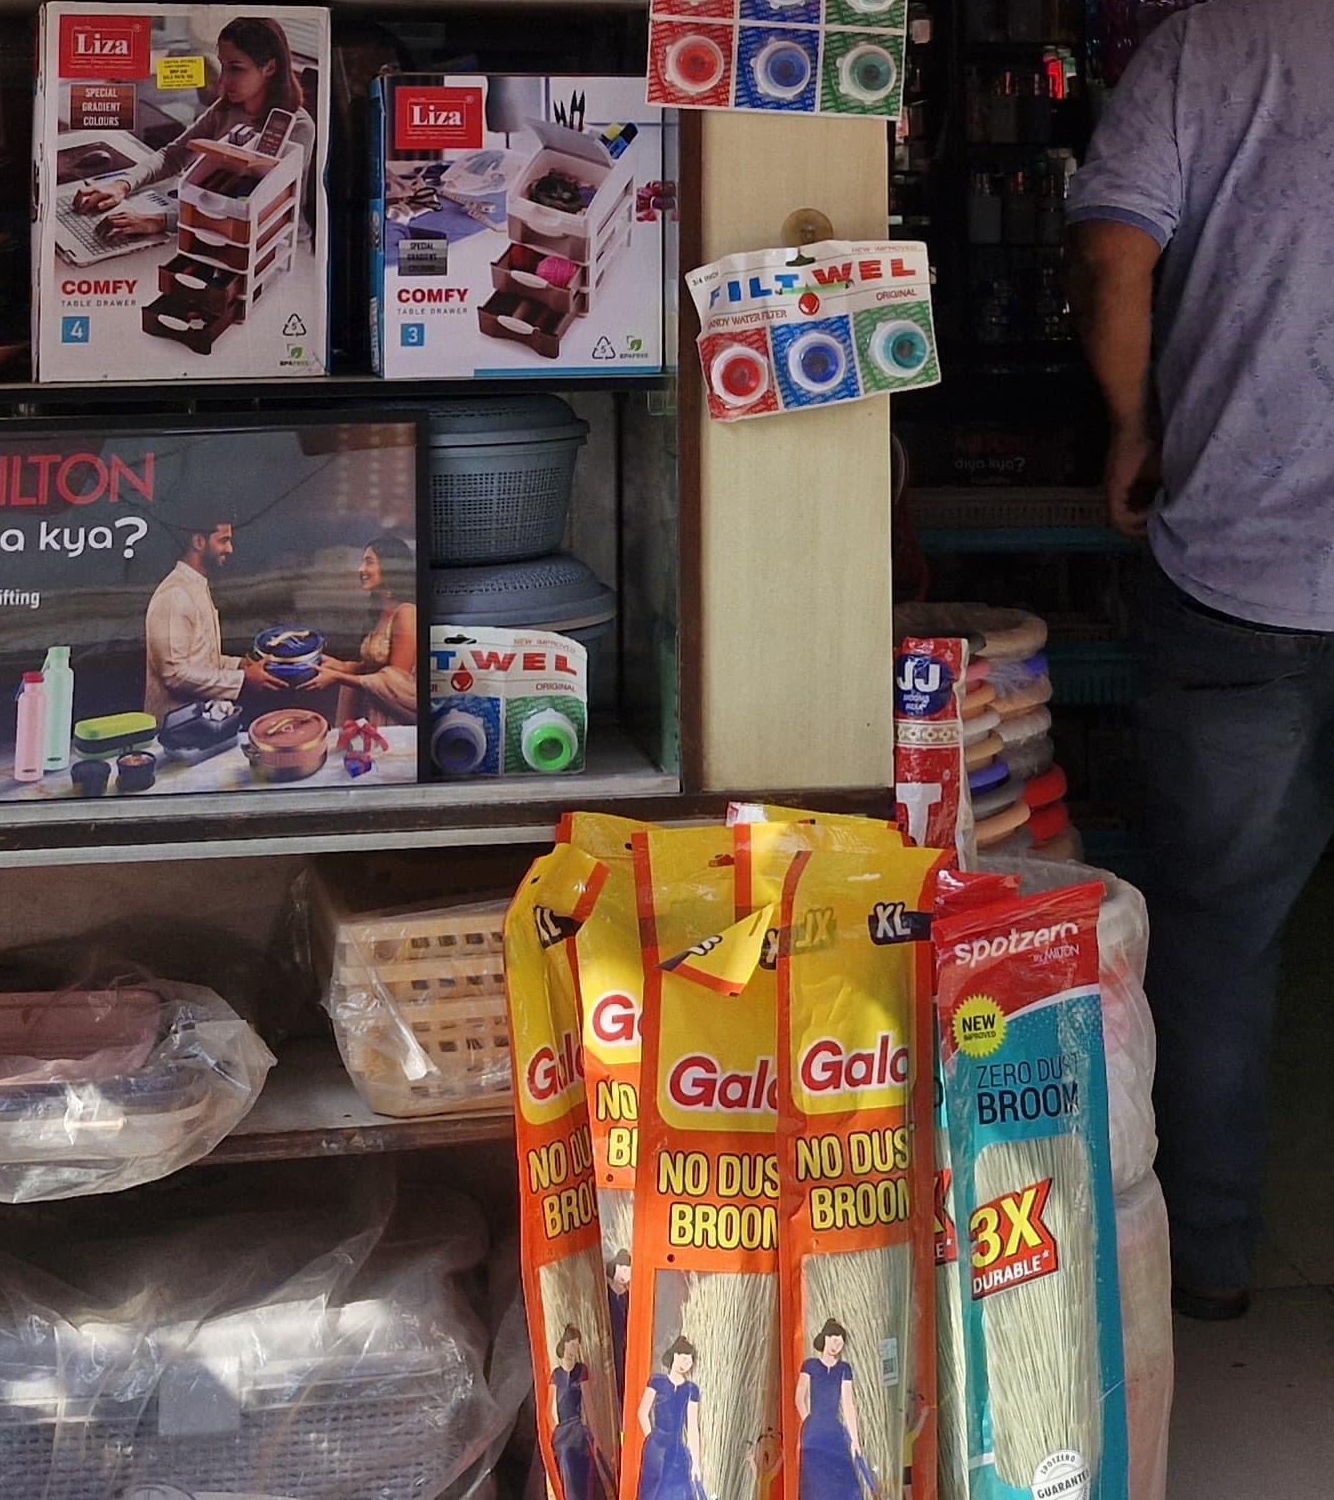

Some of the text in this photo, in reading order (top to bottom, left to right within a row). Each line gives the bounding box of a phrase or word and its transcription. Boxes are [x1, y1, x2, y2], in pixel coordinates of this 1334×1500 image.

[75, 33, 128, 55] Liza
[85, 87, 117, 98] SPECIAL
[82, 102, 120, 112] GRADIENT
[411, 105, 462, 127] Liza
[83, 116, 120, 126] COLOURS
[61, 280, 137, 295] COMFY
[397, 288, 468, 303] COMFY
[70, 320, 83, 338] 4
[707, 317, 731, 330] ANDY
[407, 327, 418, 343] 3
[39, 516, 149, 560] kya?
[875, 904, 912, 940] XL
[962, 1012, 997, 1032] NEW
[977, 1059, 1031, 1089] ZERO
[977, 1082, 1079, 1126] BROOM
[795, 1125, 914, 1182] NO DUS
[528, 1139, 567, 1195] NO
[658, 1151, 779, 1200] NO DUS
[970, 1187, 1045, 1269] 3X
